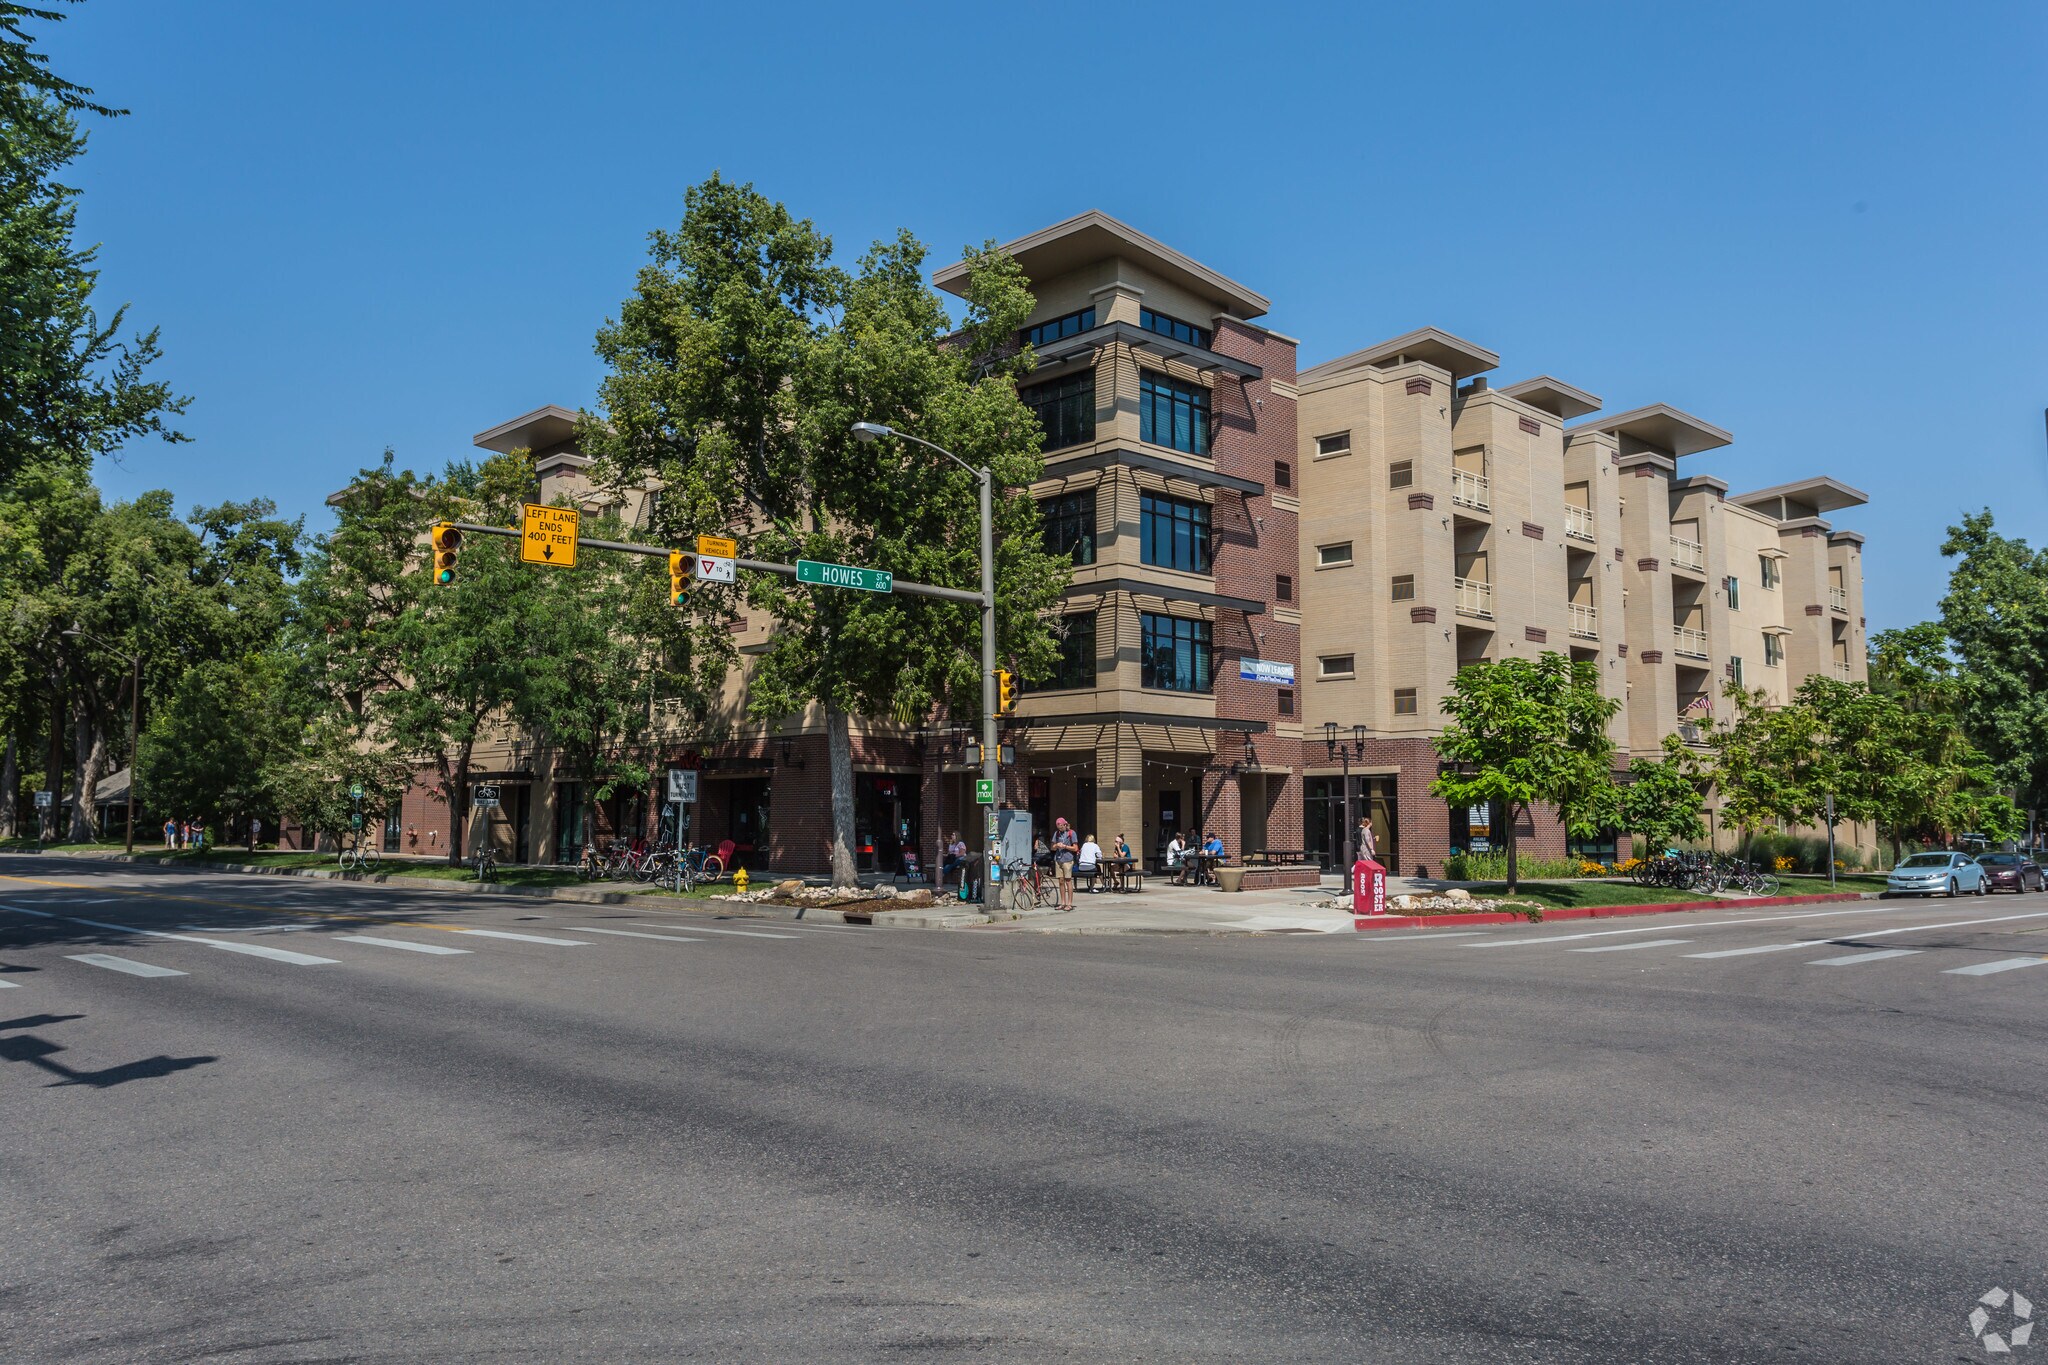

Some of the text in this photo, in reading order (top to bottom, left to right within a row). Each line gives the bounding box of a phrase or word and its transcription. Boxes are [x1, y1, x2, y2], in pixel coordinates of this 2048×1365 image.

[526, 509, 576, 524] LEFT LANE
[539, 521, 563, 533] ENDS
[527, 531, 573, 545] 400 FEET
[706, 540, 728, 548] TURNING
[705, 547, 729, 556] VEHICLES
[803, 566, 884, 587] S HOWES ST
[875, 581, 887, 590] 600
[1256, 662, 1294, 677] NOW LEASING
[675, 782, 690, 790] MUST
